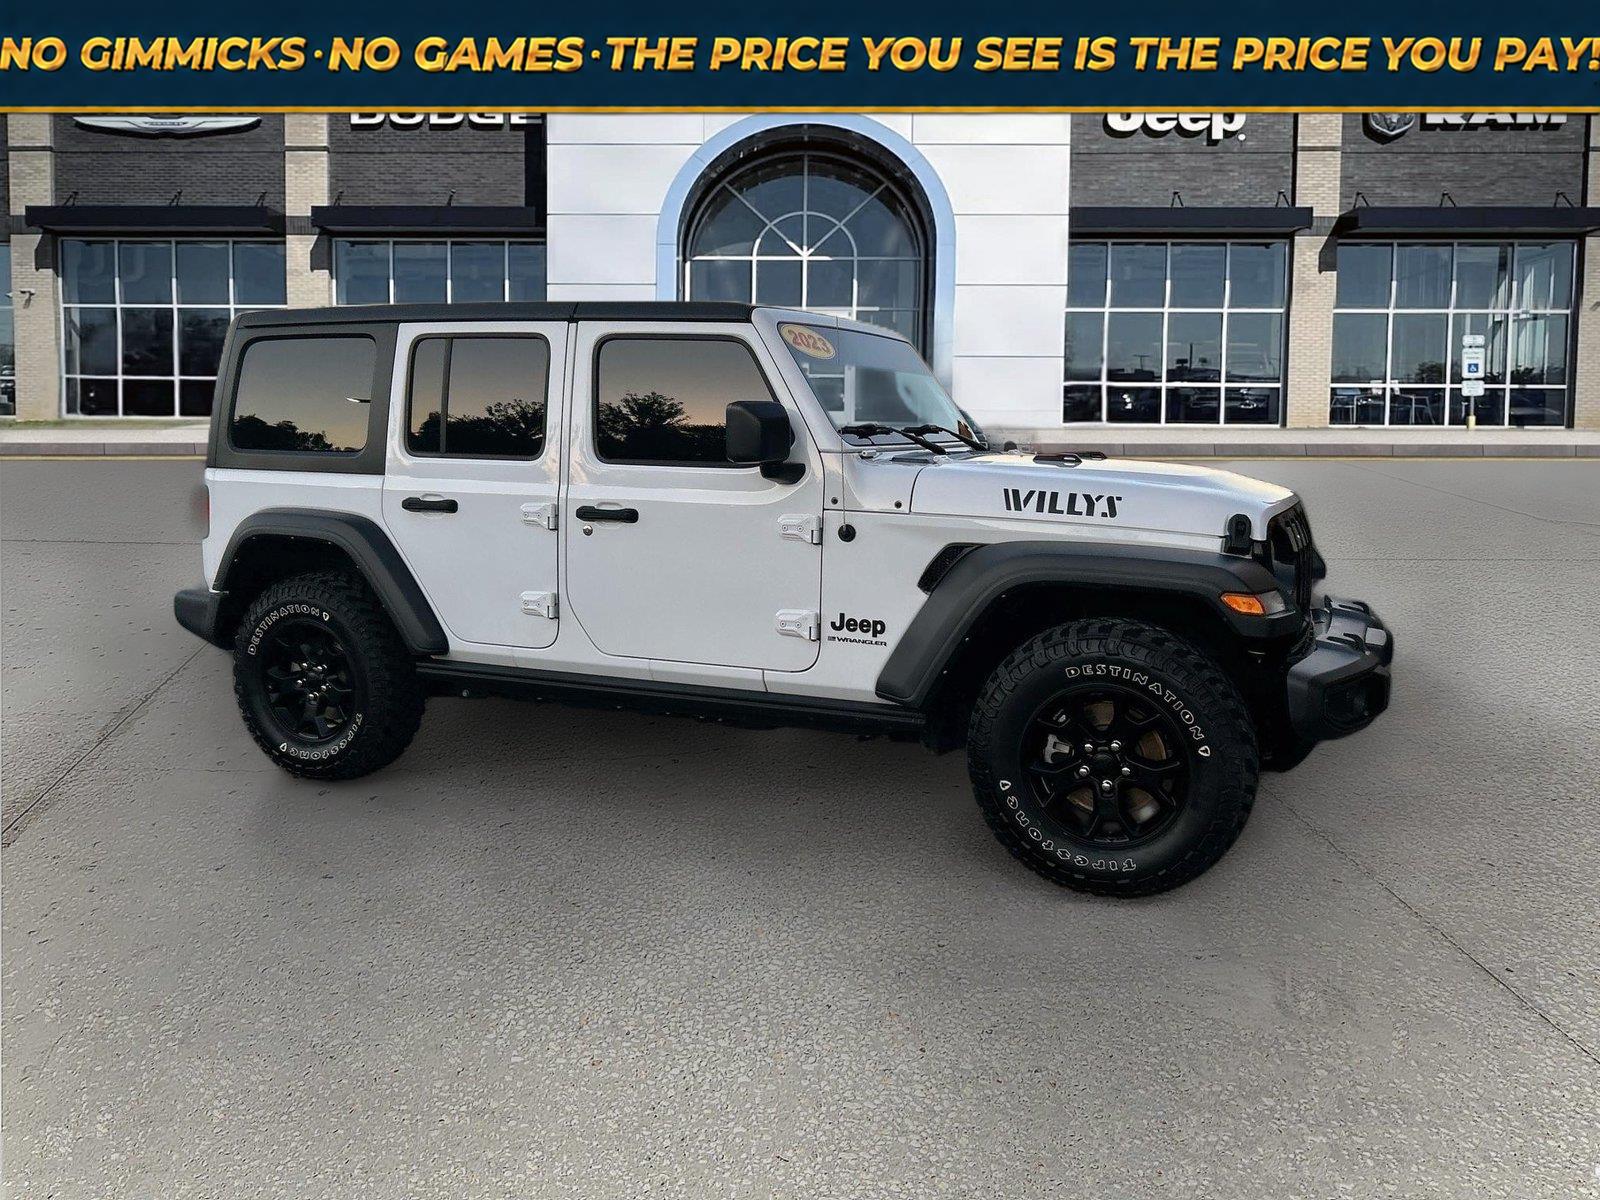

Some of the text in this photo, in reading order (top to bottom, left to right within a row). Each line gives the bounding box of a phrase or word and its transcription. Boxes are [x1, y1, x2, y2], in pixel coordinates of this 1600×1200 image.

[787, 329, 831, 354] 2023
[1003, 488, 1123, 519] WILLYS
[248, 604, 320, 656] DESTINATION
[830, 612, 886, 638] Jeep
[836, 636, 887, 647] WRANGLER
[1065, 663, 1205, 741] DESTINATION
